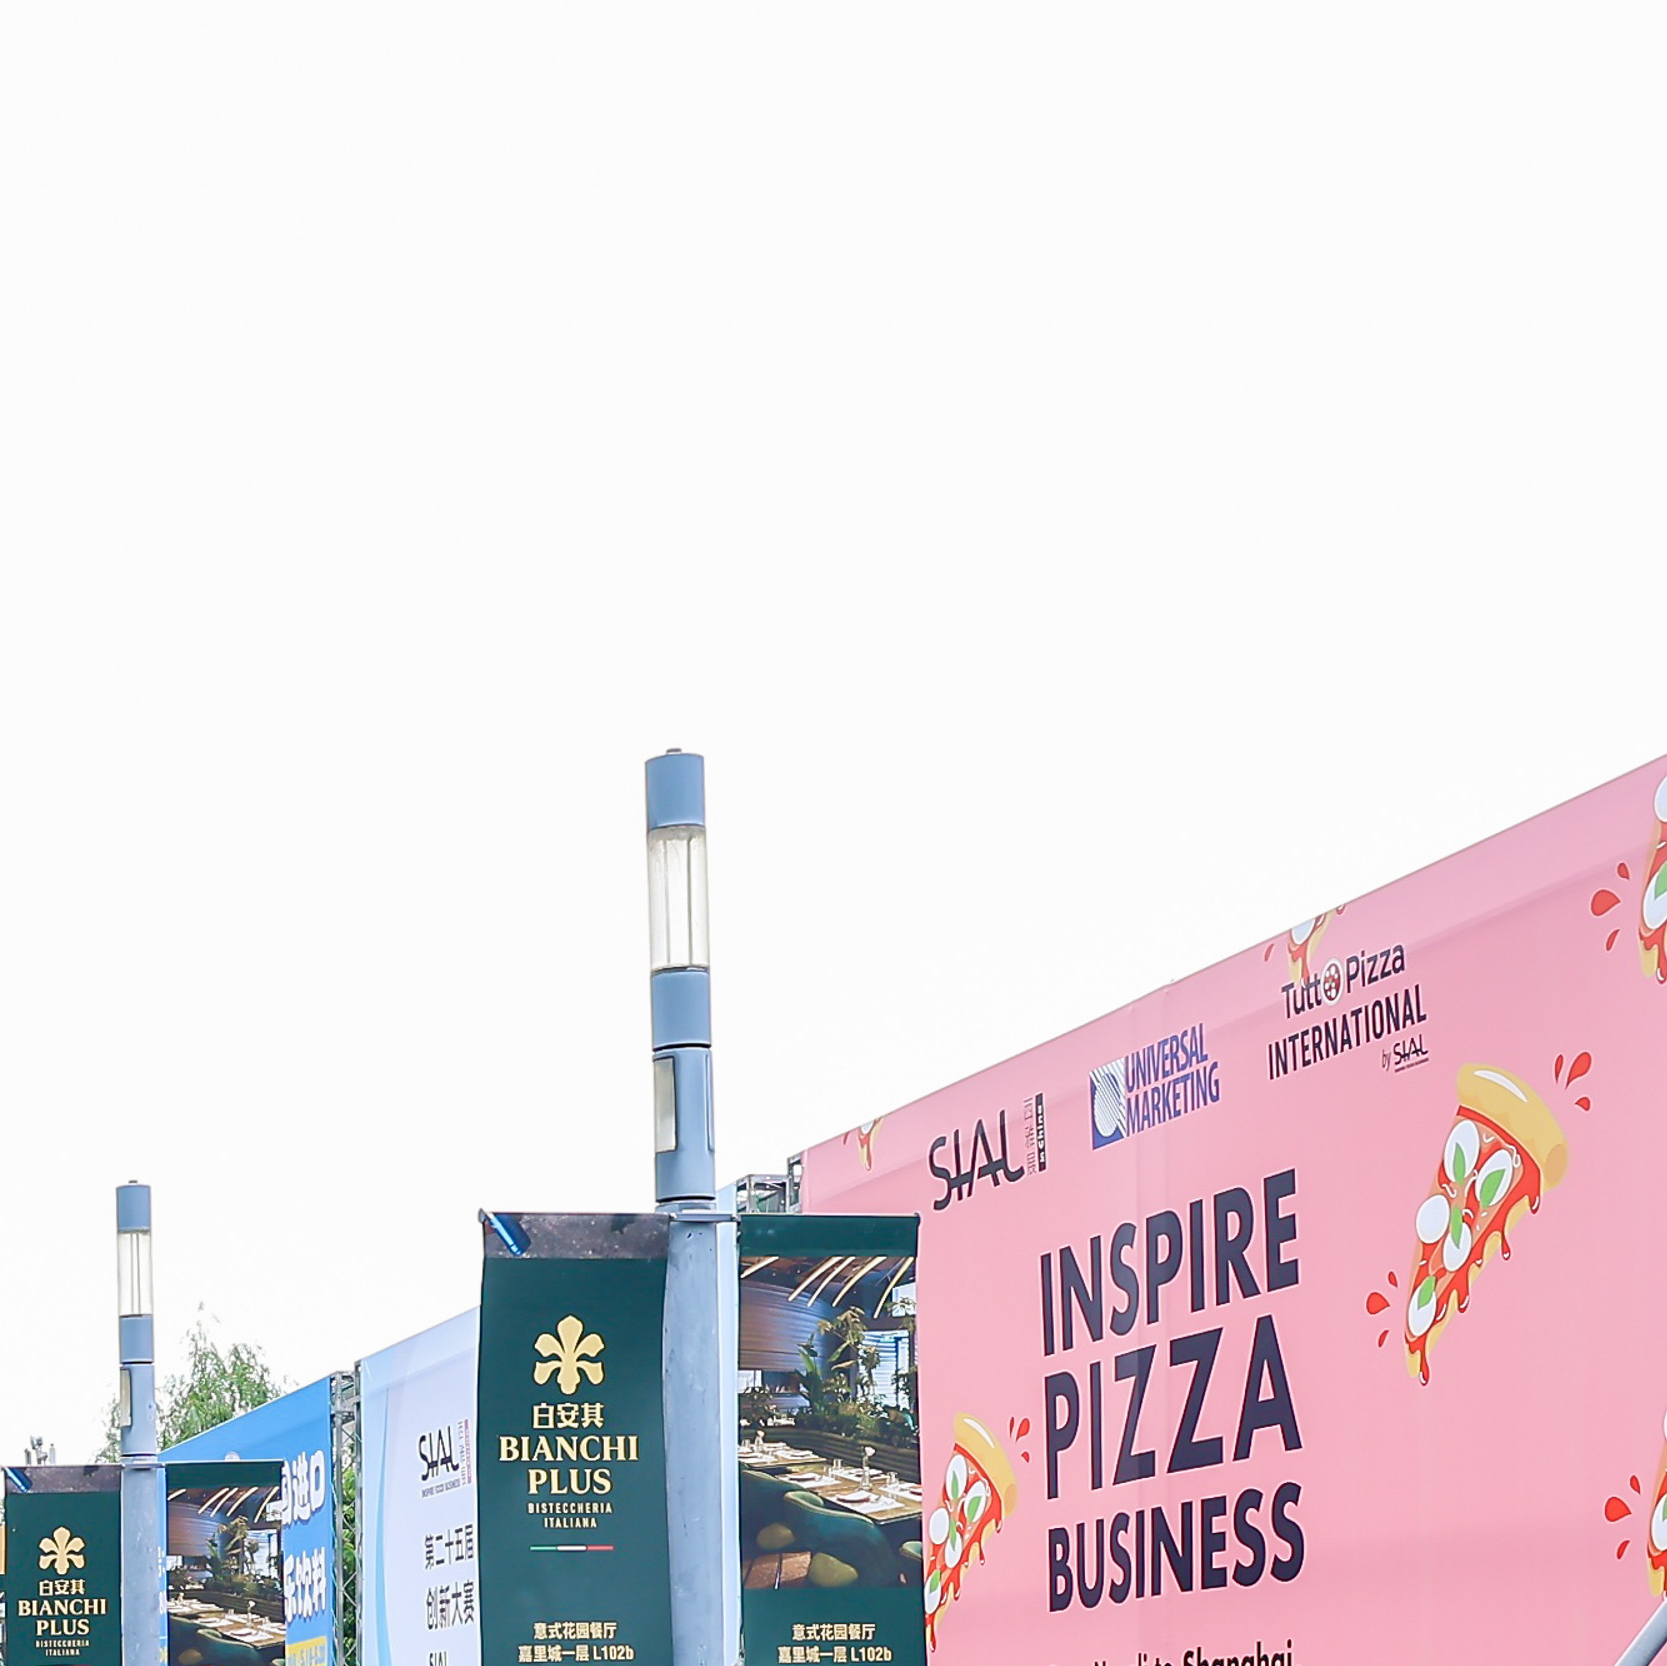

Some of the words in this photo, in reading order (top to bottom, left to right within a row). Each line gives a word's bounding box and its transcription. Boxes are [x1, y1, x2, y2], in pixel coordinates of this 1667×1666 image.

[1346, 944, 1406, 993] Pizza
[1269, 984, 1426, 1080] INTERNATIONAL
[1382, 1051, 1391, 1070] by
[1394, 1034, 1429, 1065] SIAL
[1125, 1023, 1208, 1093] UNIVERSAL
[1126, 1062, 1219, 1138] MARKETING
[929, 1109, 1025, 1210] SIAL
[1041, 1168, 1299, 1356] INSPIRE
[531, 1403, 605, 1429] 白安其
[1045, 1314, 1303, 1500] PIZZA
[419, 1426, 459, 1481] SIAL
[498, 1434, 639, 1462] BIANCHI
[527, 1469, 612, 1496] PLUS
[527, 1503, 613, 1515] BISTECCHERIA
[543, 1517, 597, 1529] ITALIANA
[425, 1524, 474, 1570] 第二十五届
[1048, 1481, 1306, 1612] BUSINESS
[18, 1598, 107, 1617] BIANCHI
[36, 1619, 90, 1636] PLUS
[426, 1579, 474, 1630] 创新大赛
[518, 1645, 590, 1663] 嘉里城一层
[593, 1644, 634, 1662] L102b
[533, 1622, 617, 1640] 意式花园餐厅
